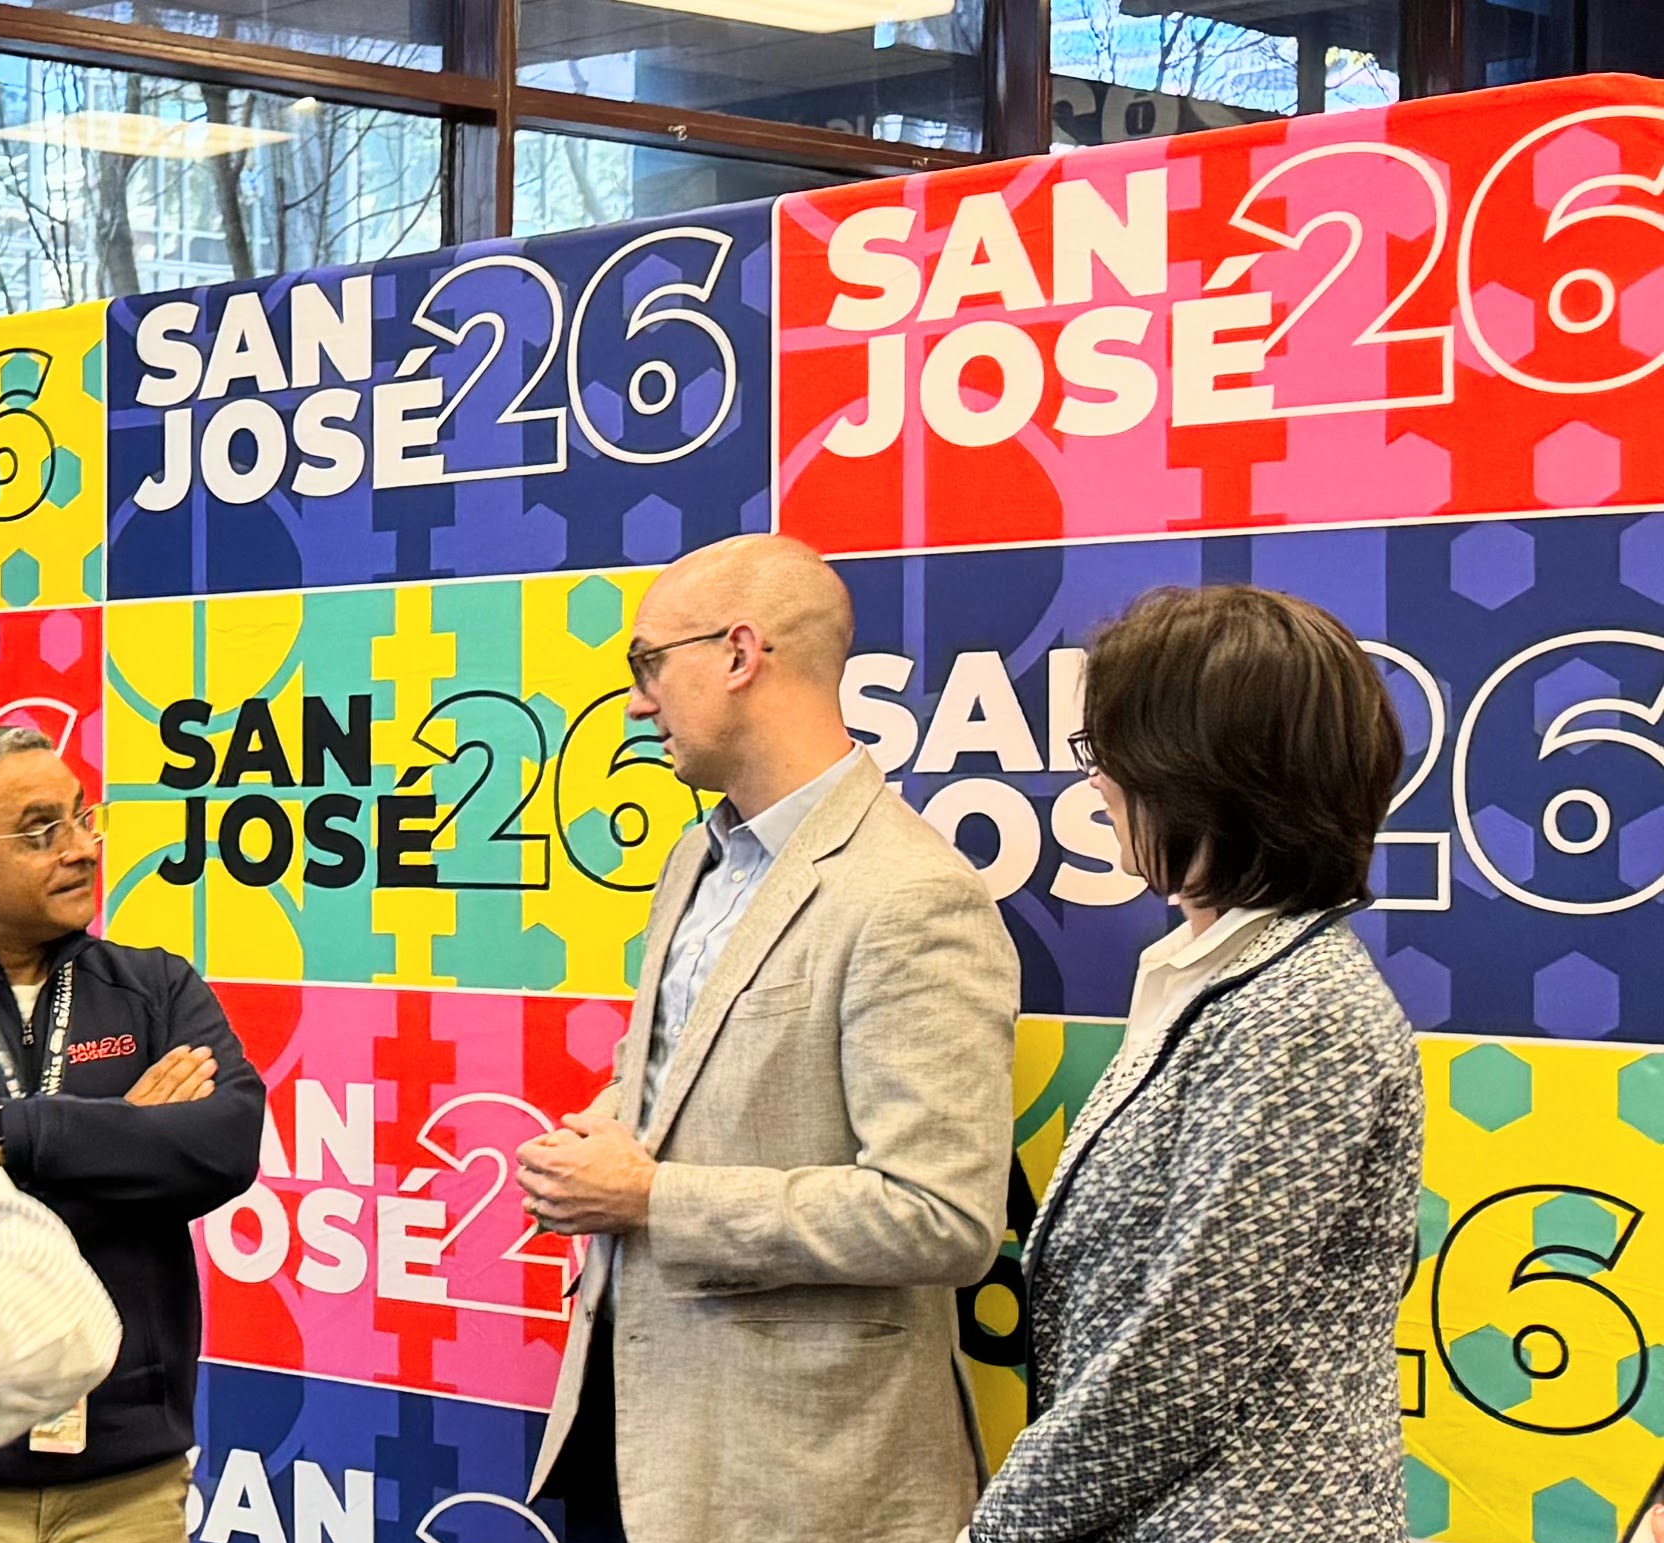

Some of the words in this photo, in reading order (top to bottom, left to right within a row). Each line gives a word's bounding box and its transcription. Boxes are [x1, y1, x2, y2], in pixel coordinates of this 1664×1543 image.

[826, 167, 1169, 331] SAN
[1230, 105, 1664, 418] 26
[135, 275, 376, 407] SAN
[411, 226, 738, 483] 26
[821, 254, 1275, 458] JOSÉ
[134, 343, 444, 512] JOSÉ
[160, 692, 372, 788] SAN
[412, 687, 702, 892] 26
[158, 764, 439, 889] JOSÉ
[885, 778, 1154, 906] OS
[67, 1041, 98, 1055] SAN
[204, 1168, 448, 1299] OSÉ
[418, 1092, 572, 1321] 2
[1399, 1184, 1648, 1437] 6
